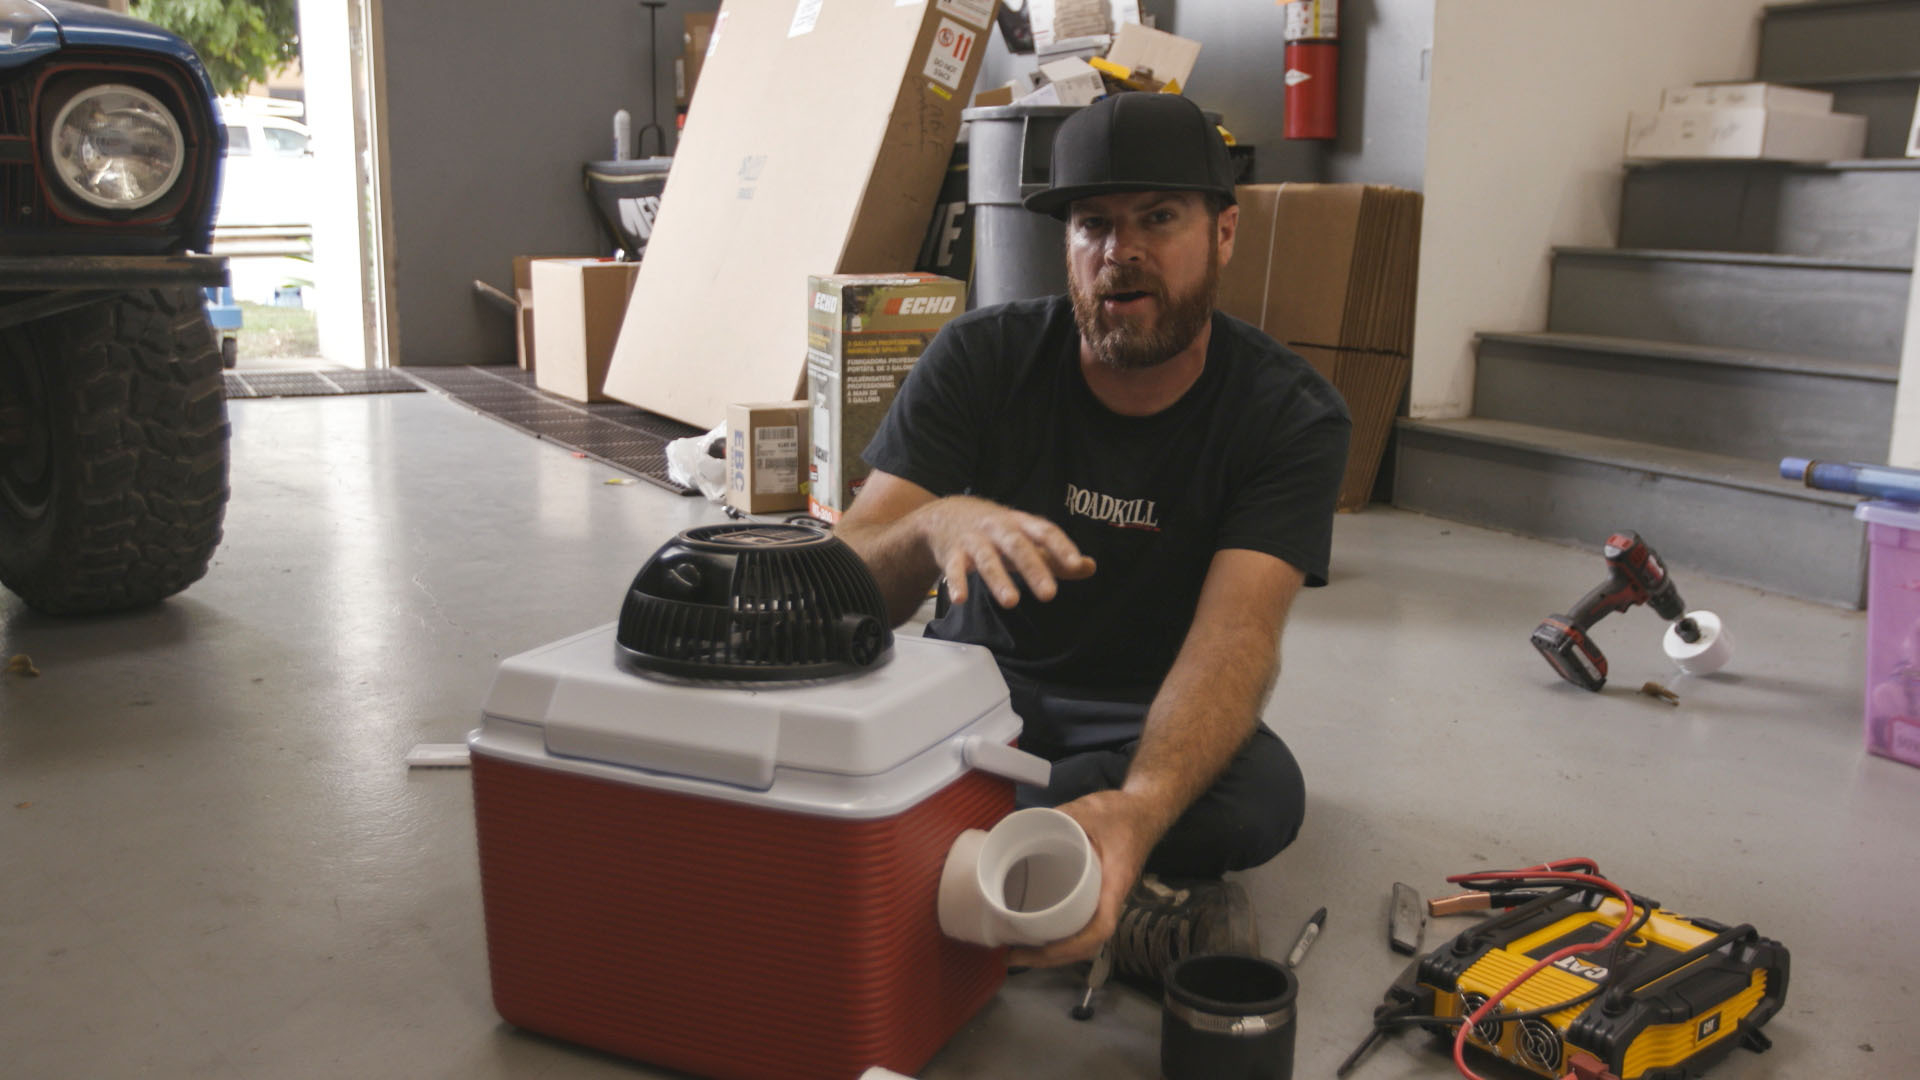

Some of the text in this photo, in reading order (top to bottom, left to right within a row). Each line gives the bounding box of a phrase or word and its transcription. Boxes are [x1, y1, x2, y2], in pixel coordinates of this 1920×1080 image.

[814, 291, 838, 314] ECHO
[899, 296, 957, 315] ECHO
[734, 429, 745, 493] EBC
[1064, 483, 1159, 528] ROADKILL
[1553, 955, 1609, 979] CAT
